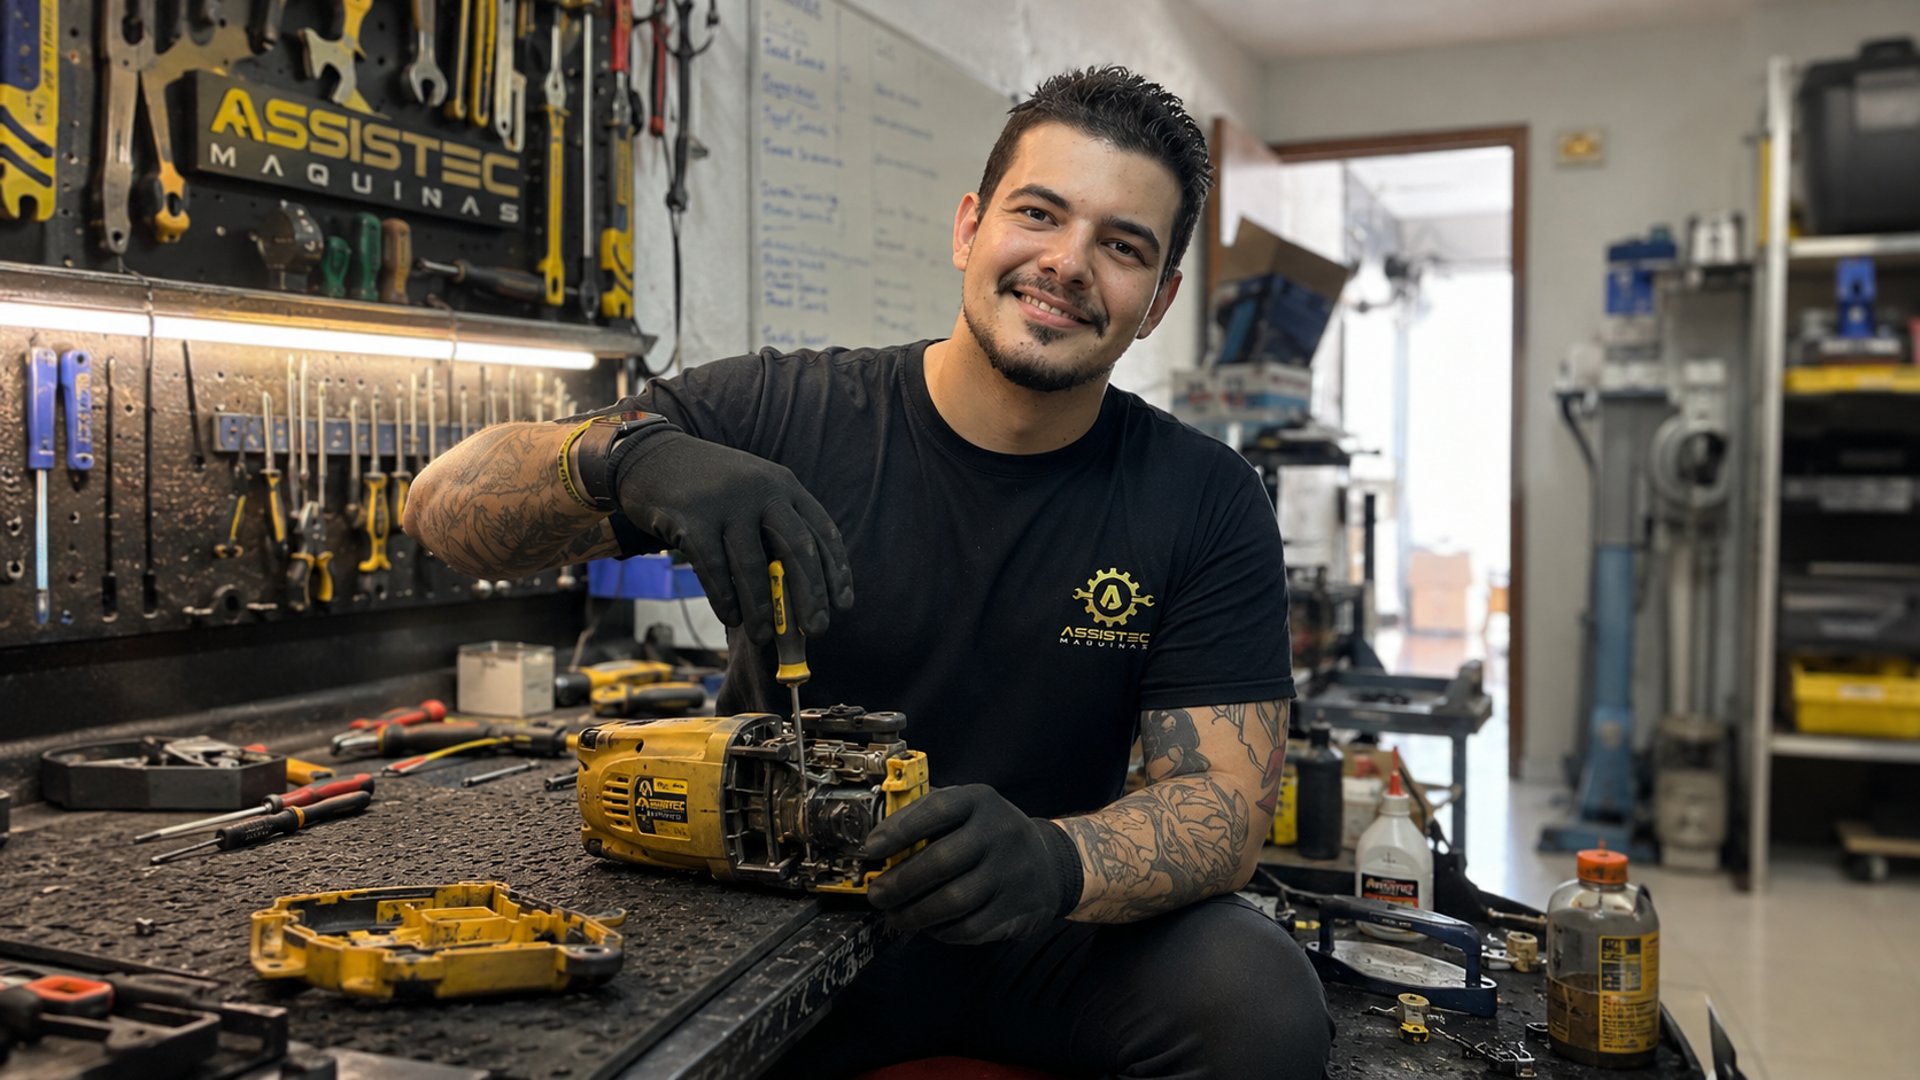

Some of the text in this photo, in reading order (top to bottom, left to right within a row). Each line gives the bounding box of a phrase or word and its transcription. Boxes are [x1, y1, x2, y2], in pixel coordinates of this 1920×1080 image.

[210, 87, 520, 198] ASSISTEC
[210, 143, 518, 223] MAQUINAS
[1059, 638, 1148, 650] MAQUINAS
[1060, 626, 1150, 643] ASSISTEC
